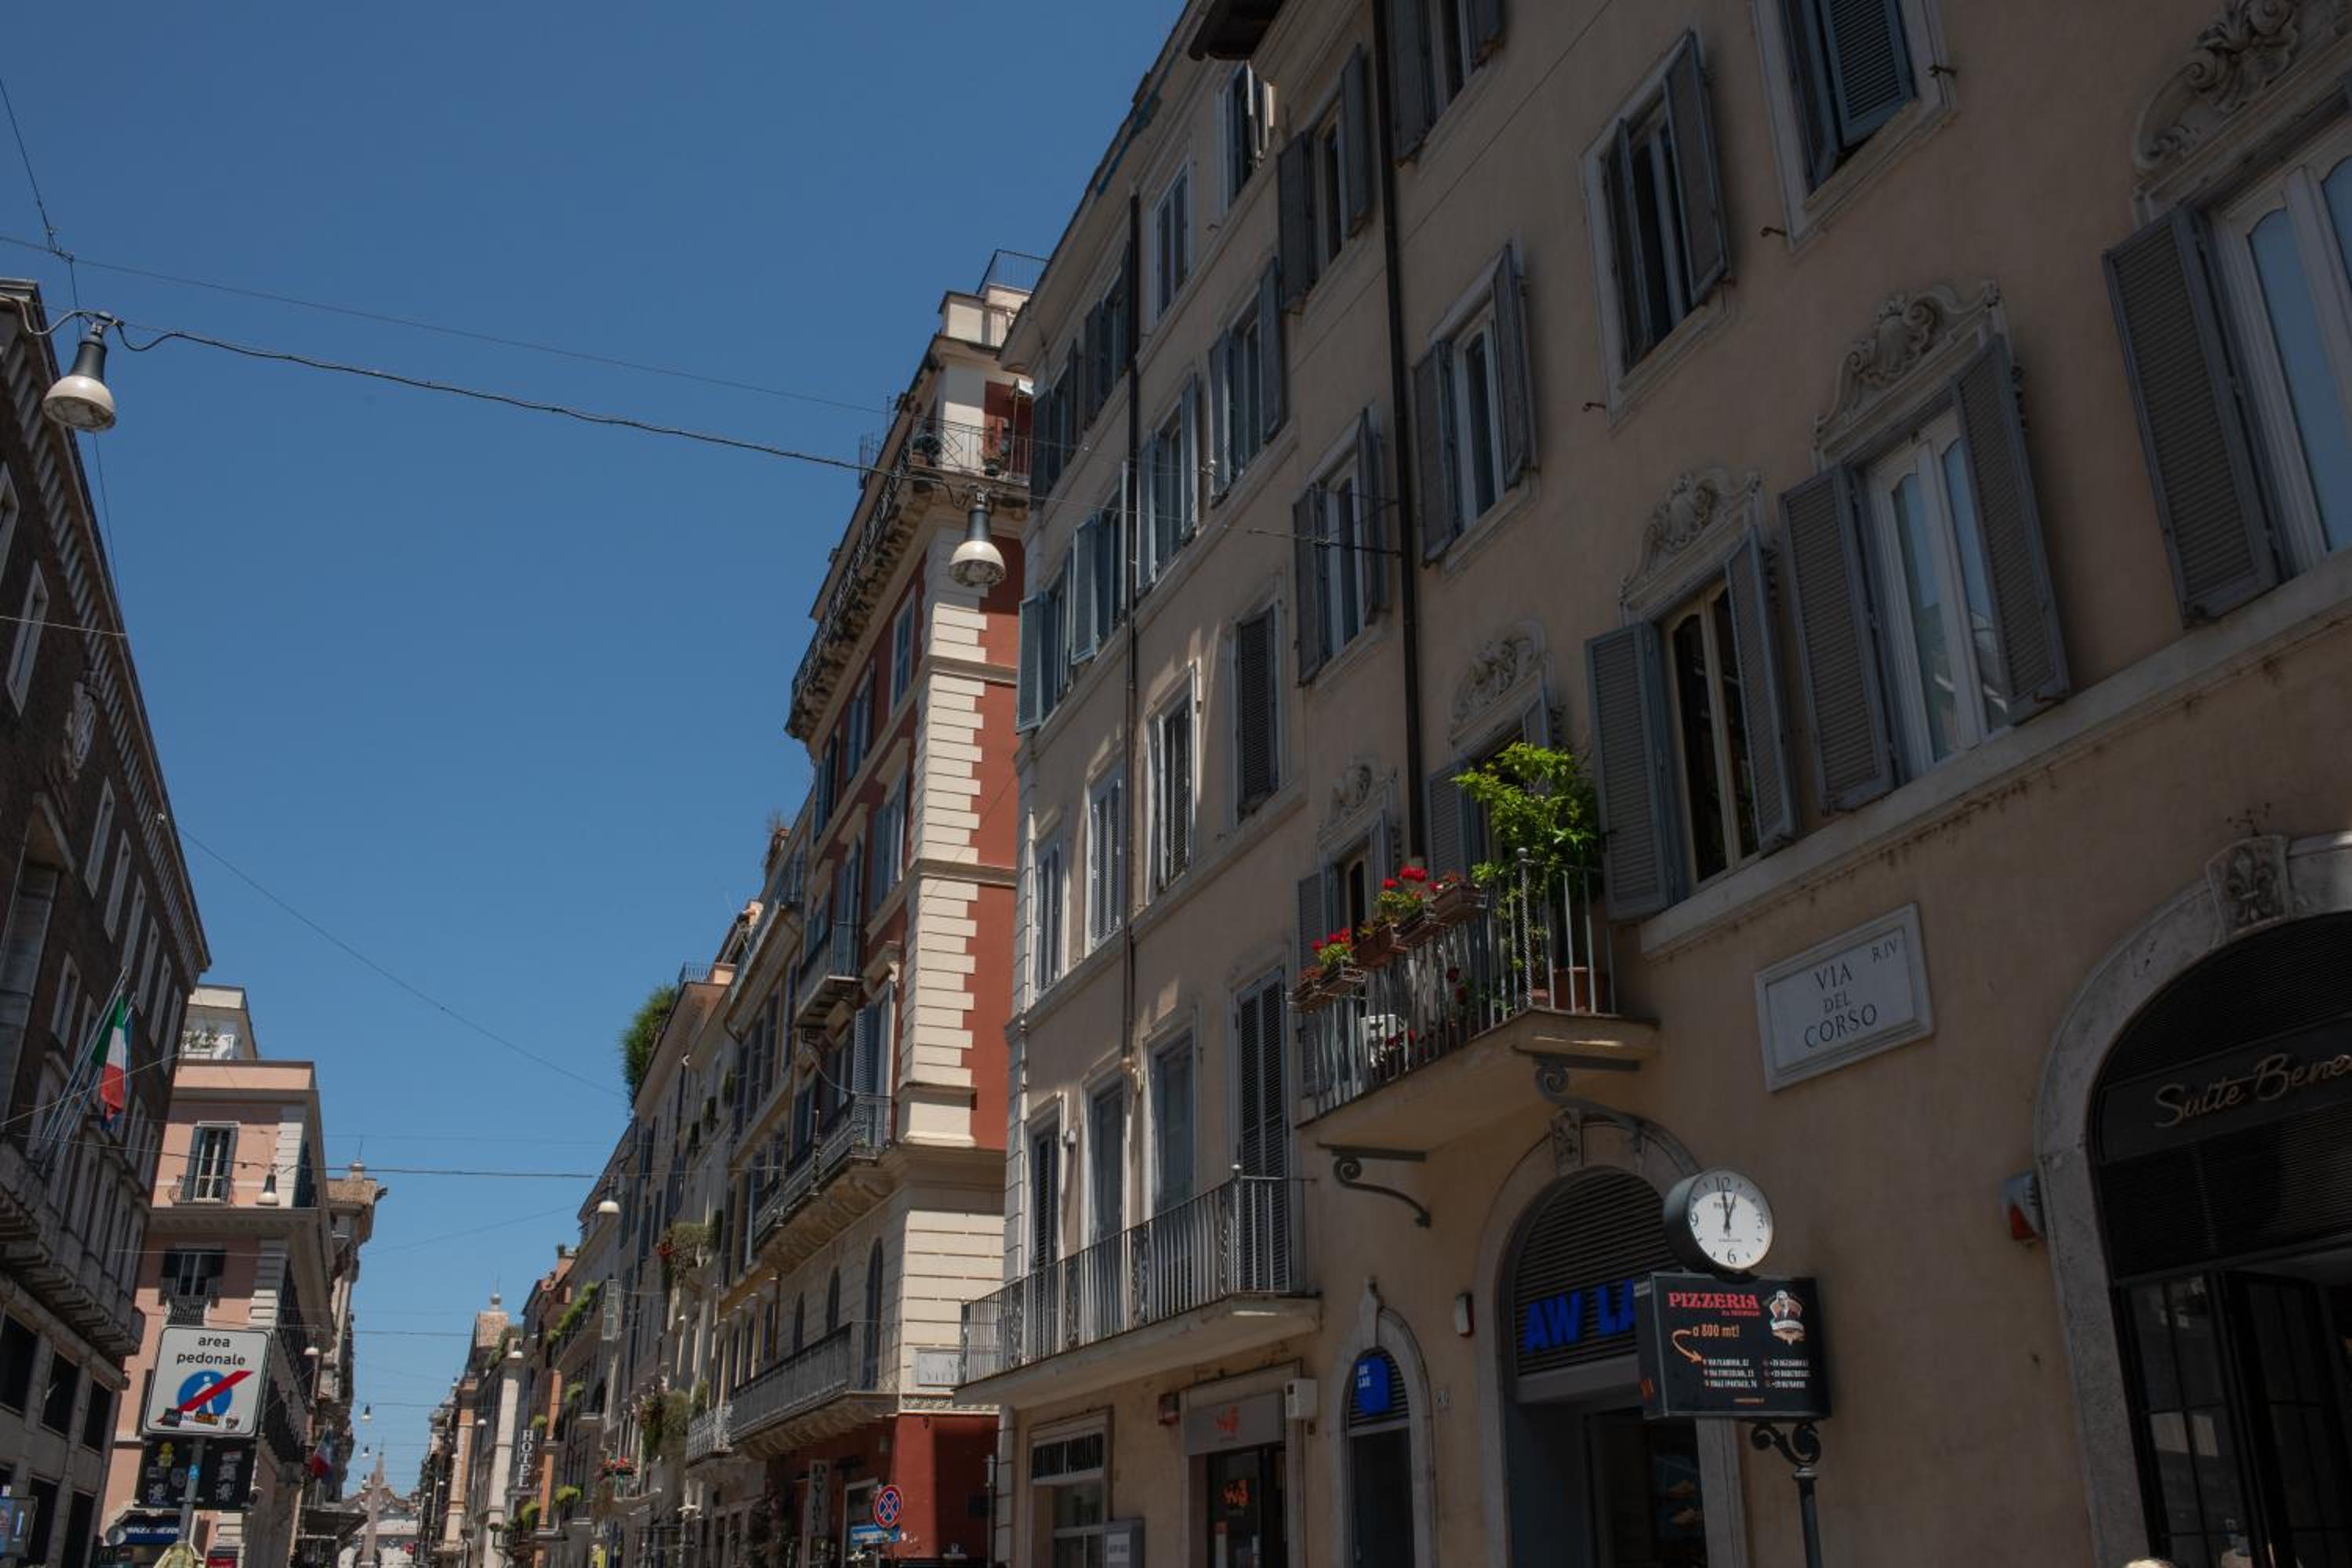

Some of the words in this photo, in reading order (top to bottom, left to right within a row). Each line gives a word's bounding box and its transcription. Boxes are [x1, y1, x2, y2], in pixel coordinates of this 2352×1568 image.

[1814, 964, 1853, 990] VIA
[1824, 993, 1851, 1014] DEL
[1804, 1004, 1877, 1048] CORSO
[2154, 1077, 2247, 1127] Suite
[2254, 1053, 2352, 1101] Bene
[1715, 1176, 1732, 1192] 12
[1727, 1249, 1737, 1265] 6
[1668, 1292, 1760, 1309] PIZZERIA
[1525, 1288, 1581, 1355] AW
[1595, 1279, 1635, 1337] LA
[198, 1337, 230, 1348] area
[176, 1352, 245, 1366] pedonale
[517, 1429, 535, 1488] HOTEL
